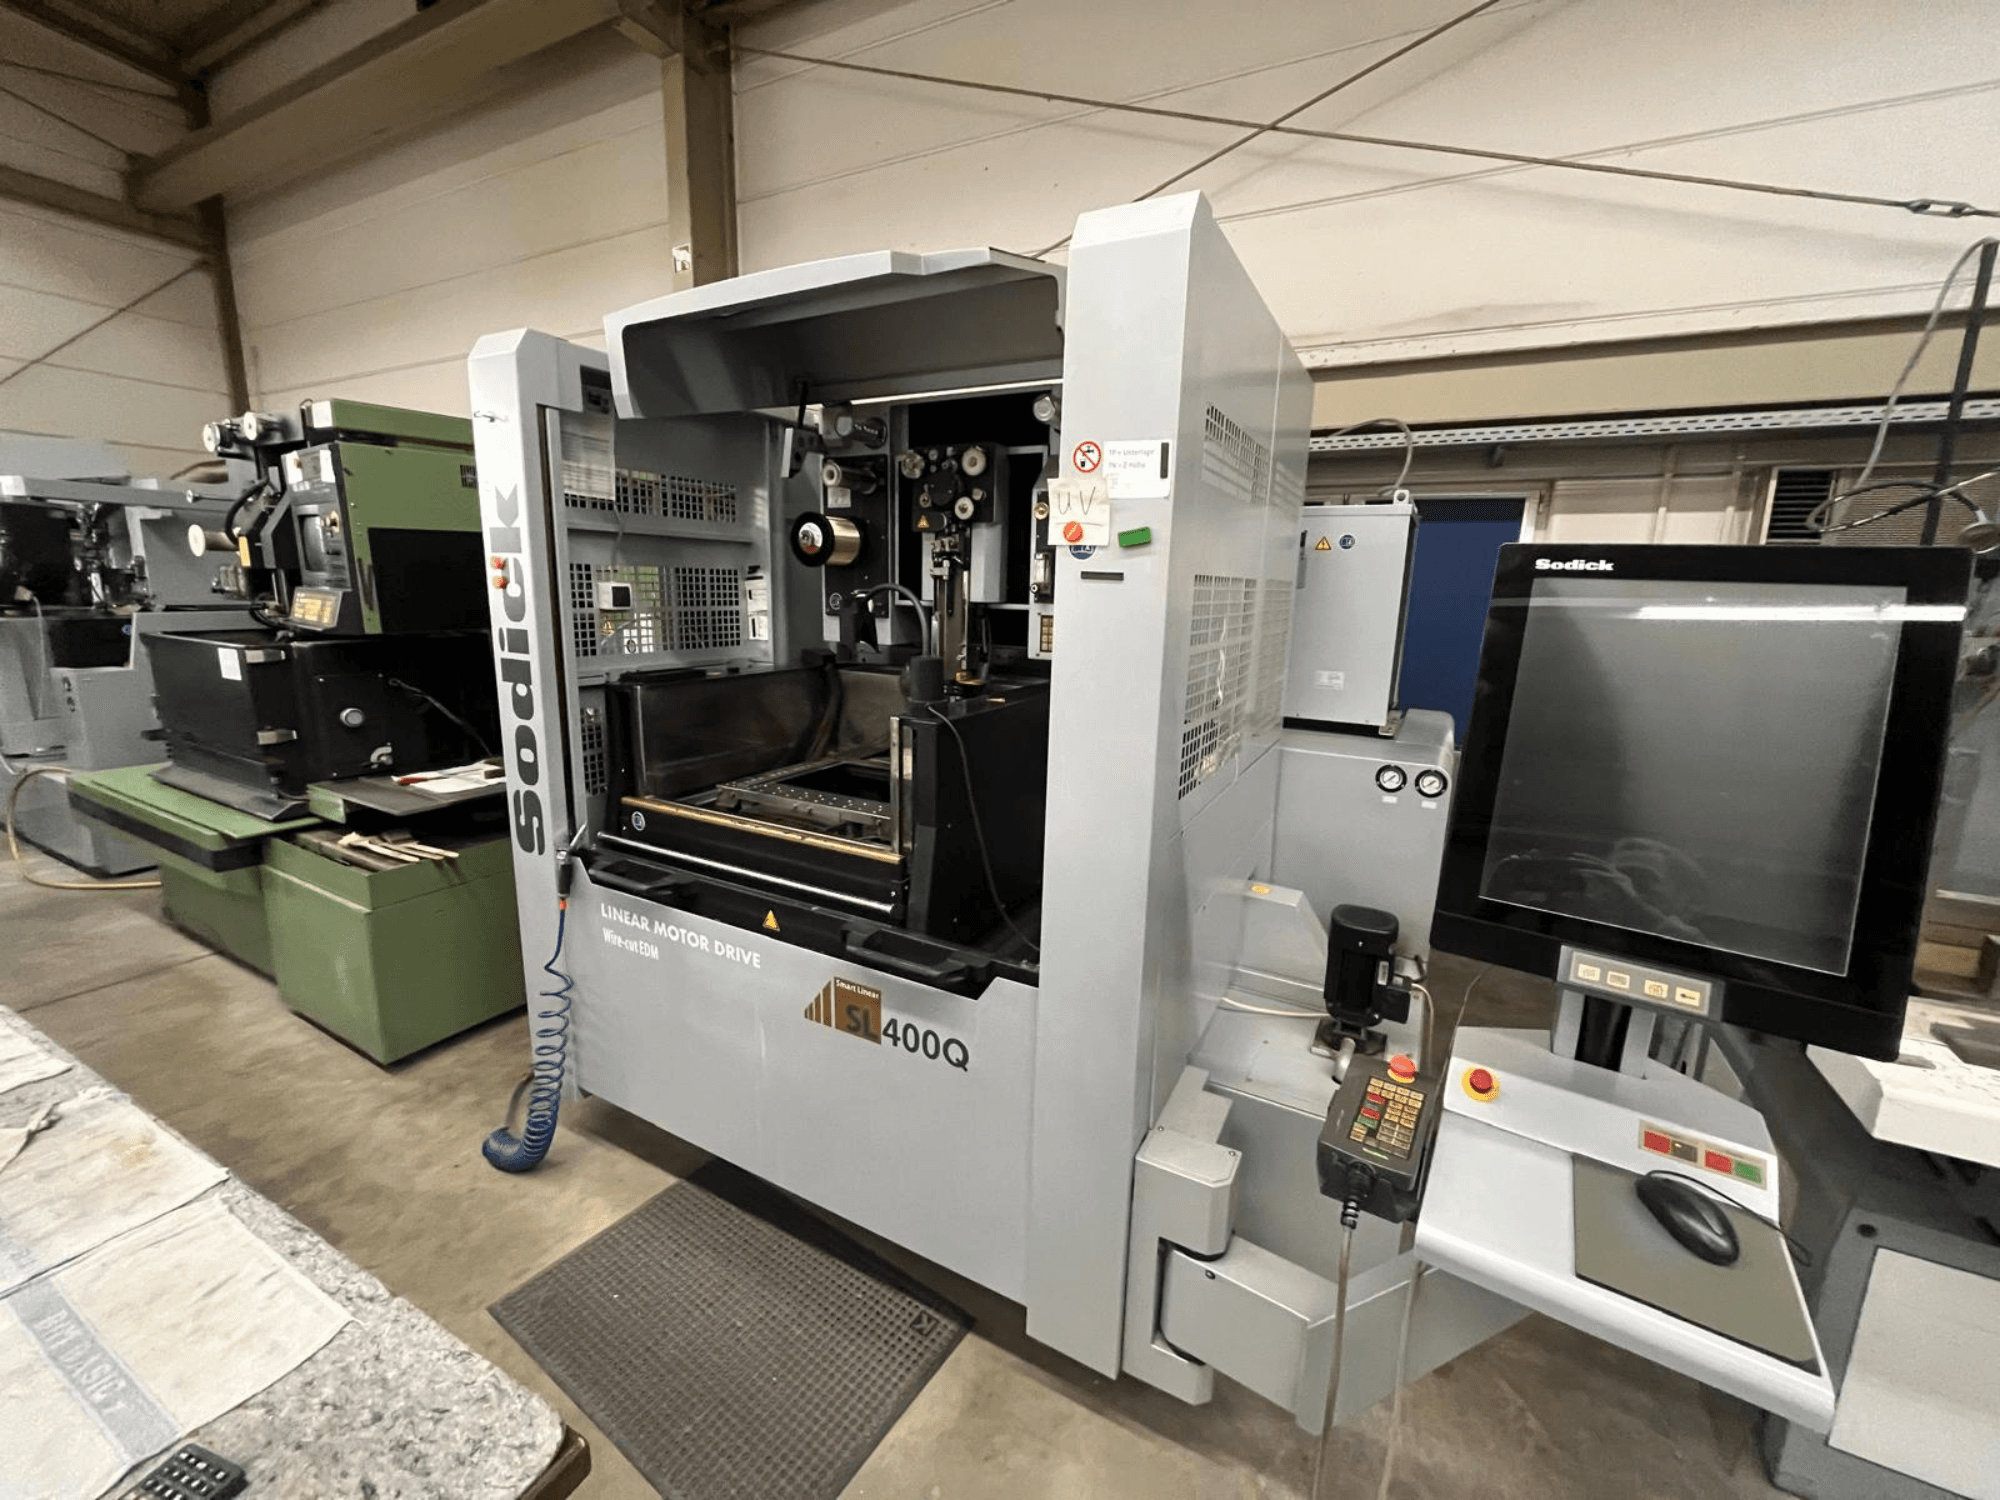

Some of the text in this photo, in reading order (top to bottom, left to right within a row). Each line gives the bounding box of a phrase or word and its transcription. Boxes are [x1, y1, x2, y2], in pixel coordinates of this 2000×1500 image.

[1534, 558, 1615, 571] Sodick
[489, 483, 546, 855] Sodick
[600, 902, 761, 969] LINEAR MOTOR DRIVE
[602, 926, 659, 960] Wire-cut EDM
[835, 979, 880, 999] Smart Linear
